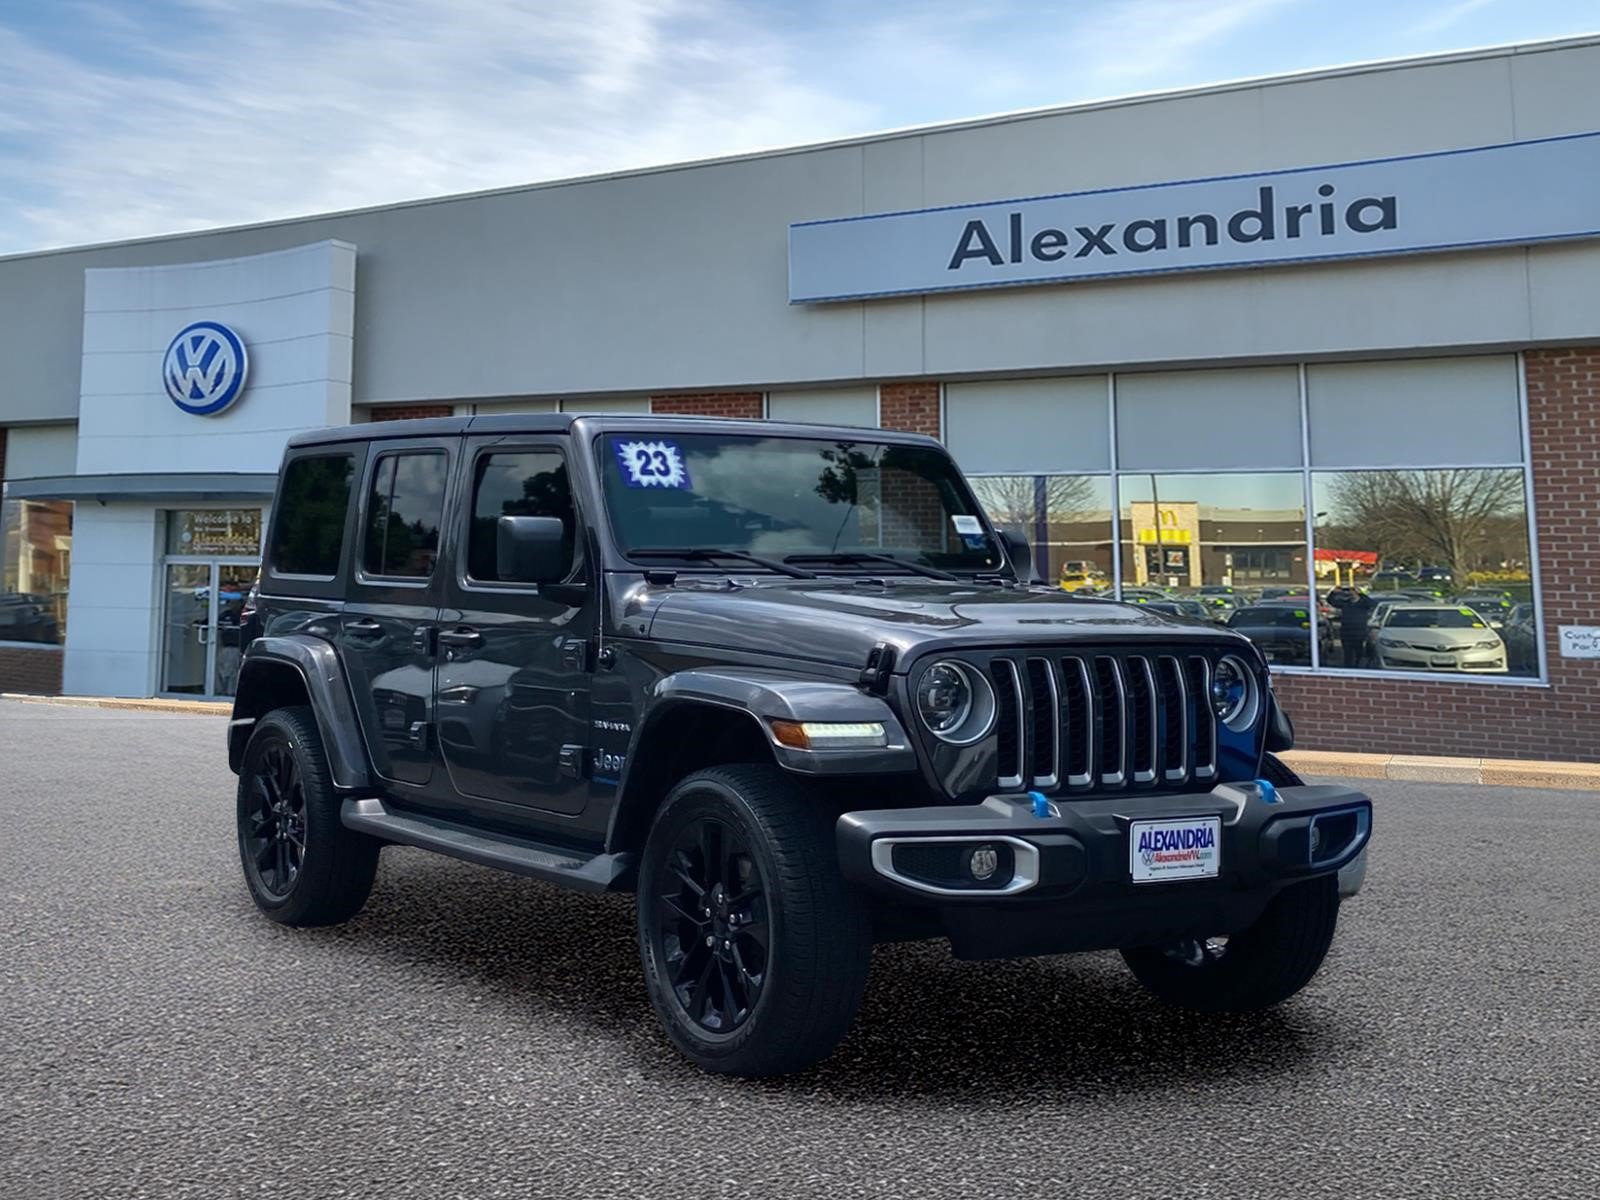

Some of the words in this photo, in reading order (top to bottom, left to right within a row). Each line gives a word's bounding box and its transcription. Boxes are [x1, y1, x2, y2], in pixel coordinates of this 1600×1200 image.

[947, 182, 1398, 271] Alexandria
[166, 328, 235, 406] VW
[636, 449, 671, 477] 23
[1138, 827, 1215, 853] ALEXANDRIA
